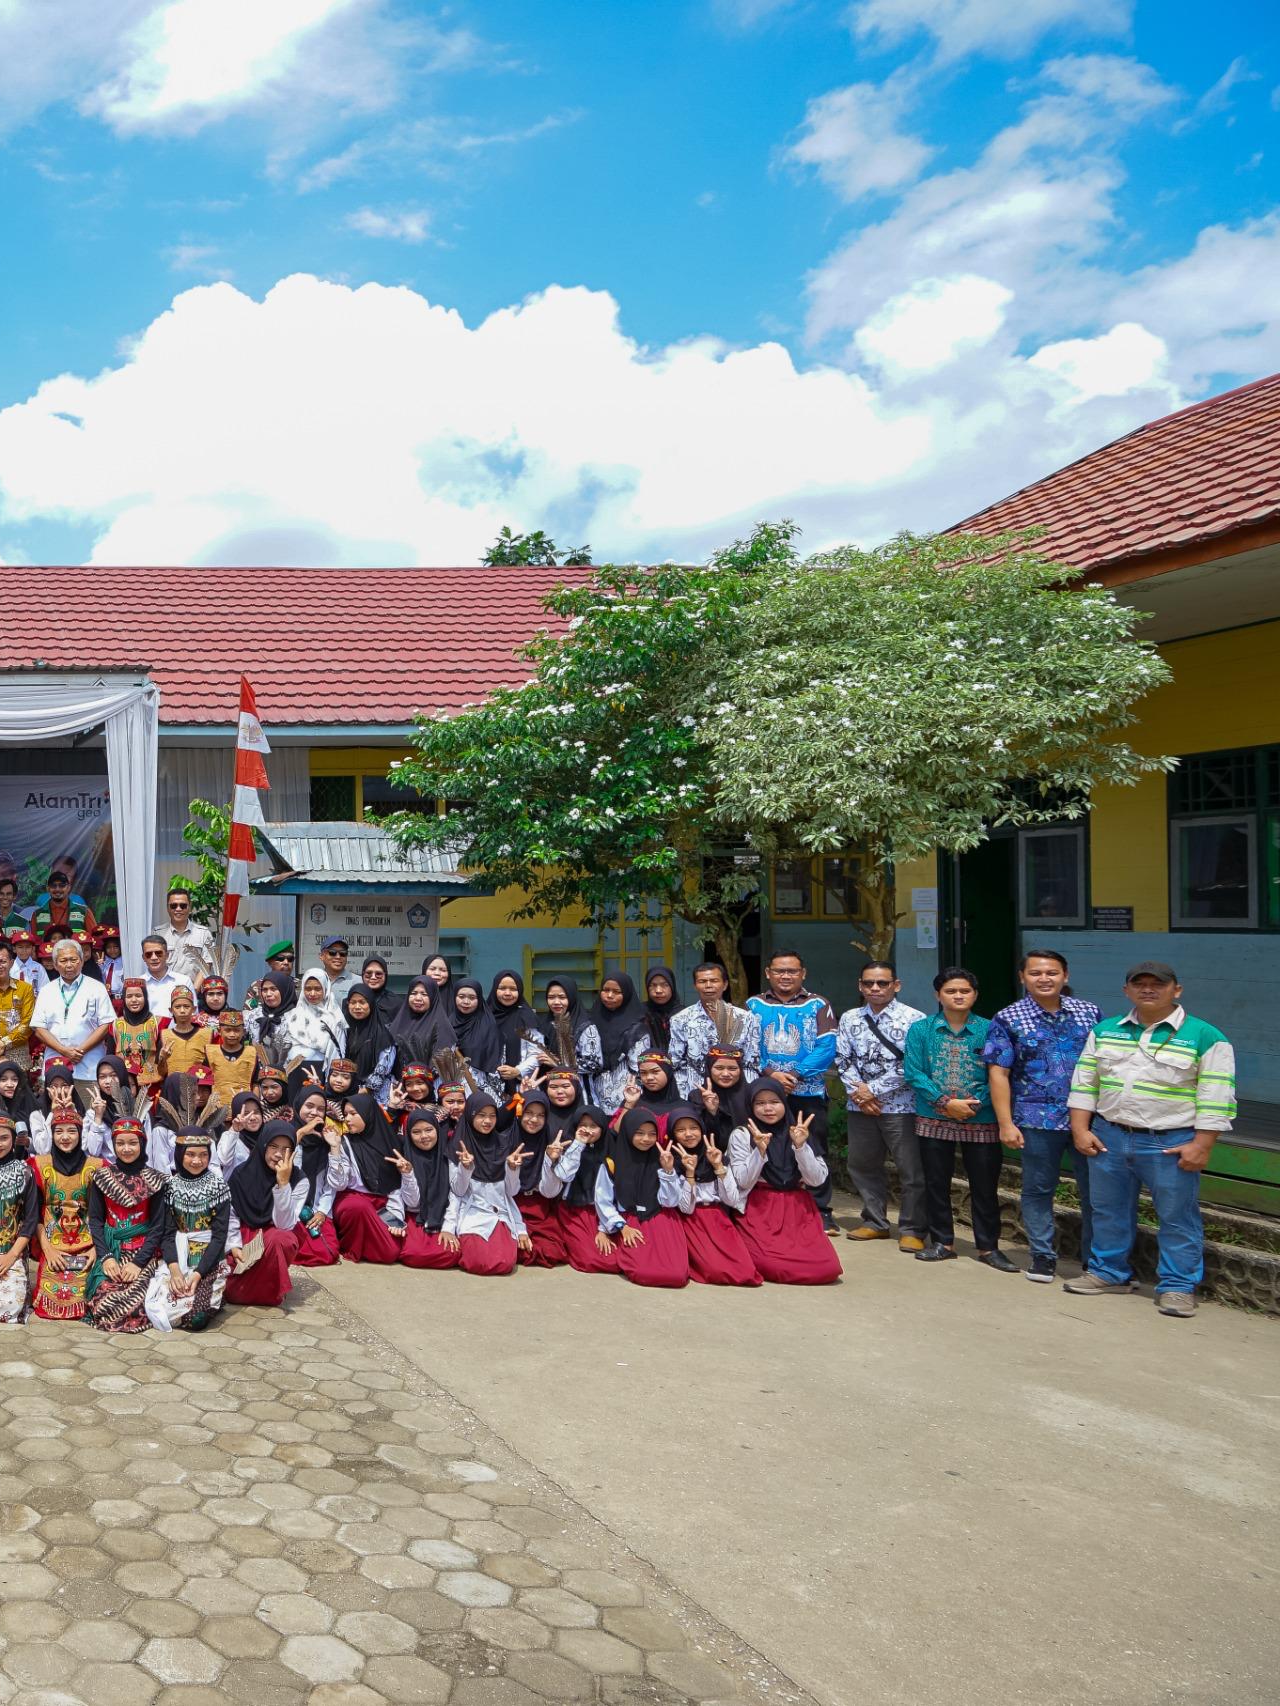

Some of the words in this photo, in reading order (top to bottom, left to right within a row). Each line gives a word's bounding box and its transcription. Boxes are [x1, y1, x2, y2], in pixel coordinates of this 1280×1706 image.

[24, 793, 101, 808] AlamTri
[78, 810, 101, 821] geo
[345, 916, 360, 926] DINAS
[362, 916, 391, 926] PENDIDIKAN
[357, 935, 374, 946] NEGERI
[376, 935, 394, 947] MUARA
